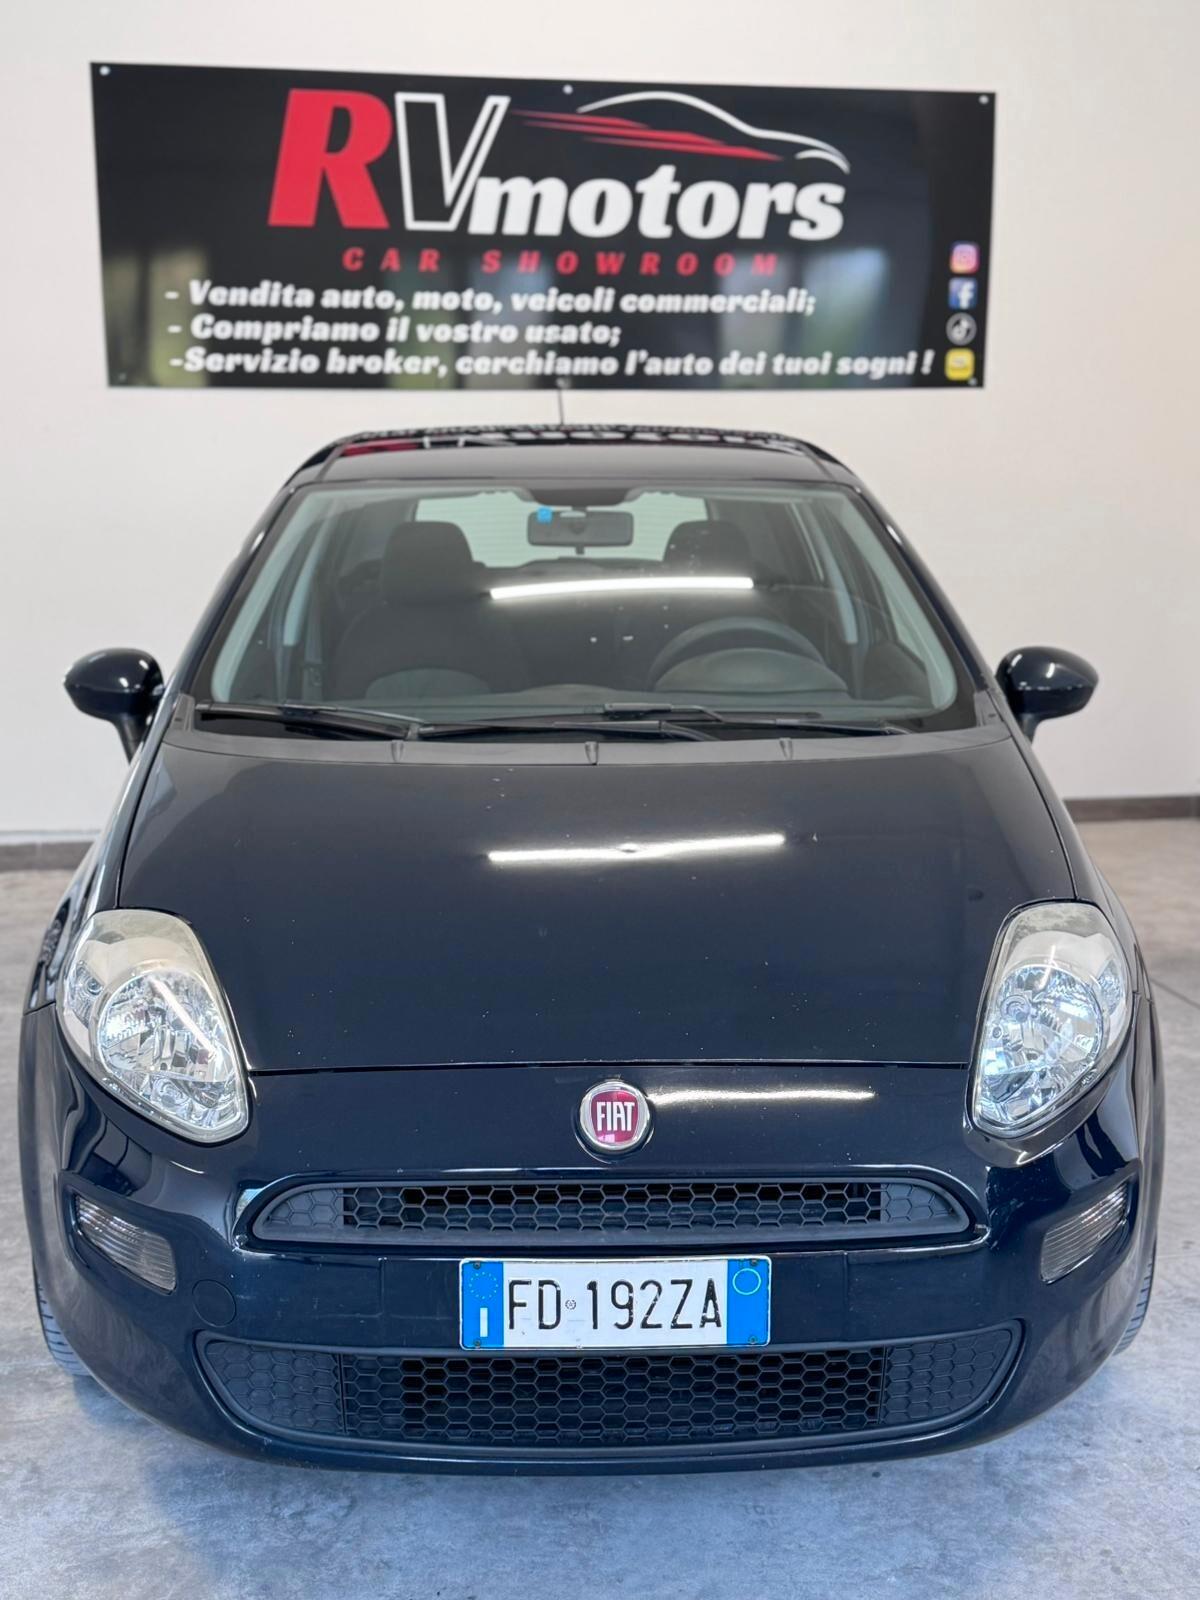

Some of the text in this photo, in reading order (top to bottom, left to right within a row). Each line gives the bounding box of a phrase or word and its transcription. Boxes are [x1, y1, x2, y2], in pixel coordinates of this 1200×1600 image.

[342, 246, 779, 278] CAR SHOWROOM
[188, 278, 316, 308] Vendita
[320, 285, 405, 314] auto,
[411, 287, 503, 315] moto,
[509, 285, 617, 313] veicoli
[618, 286, 817, 317] commerciali;
[190, 312, 381, 346] Compriamo
[385, 315, 411, 343] il
[415, 320, 520, 344] vostro
[524, 320, 623, 348] usato;
[325, 346, 449, 379] broker,
[454, 348, 620, 376] cerchiamo
[717, 349, 768, 376] dei
[771, 350, 834, 376] tuoi
[834, 350, 919, 381] sogni
[596, 1101, 635, 1132] FIAT
